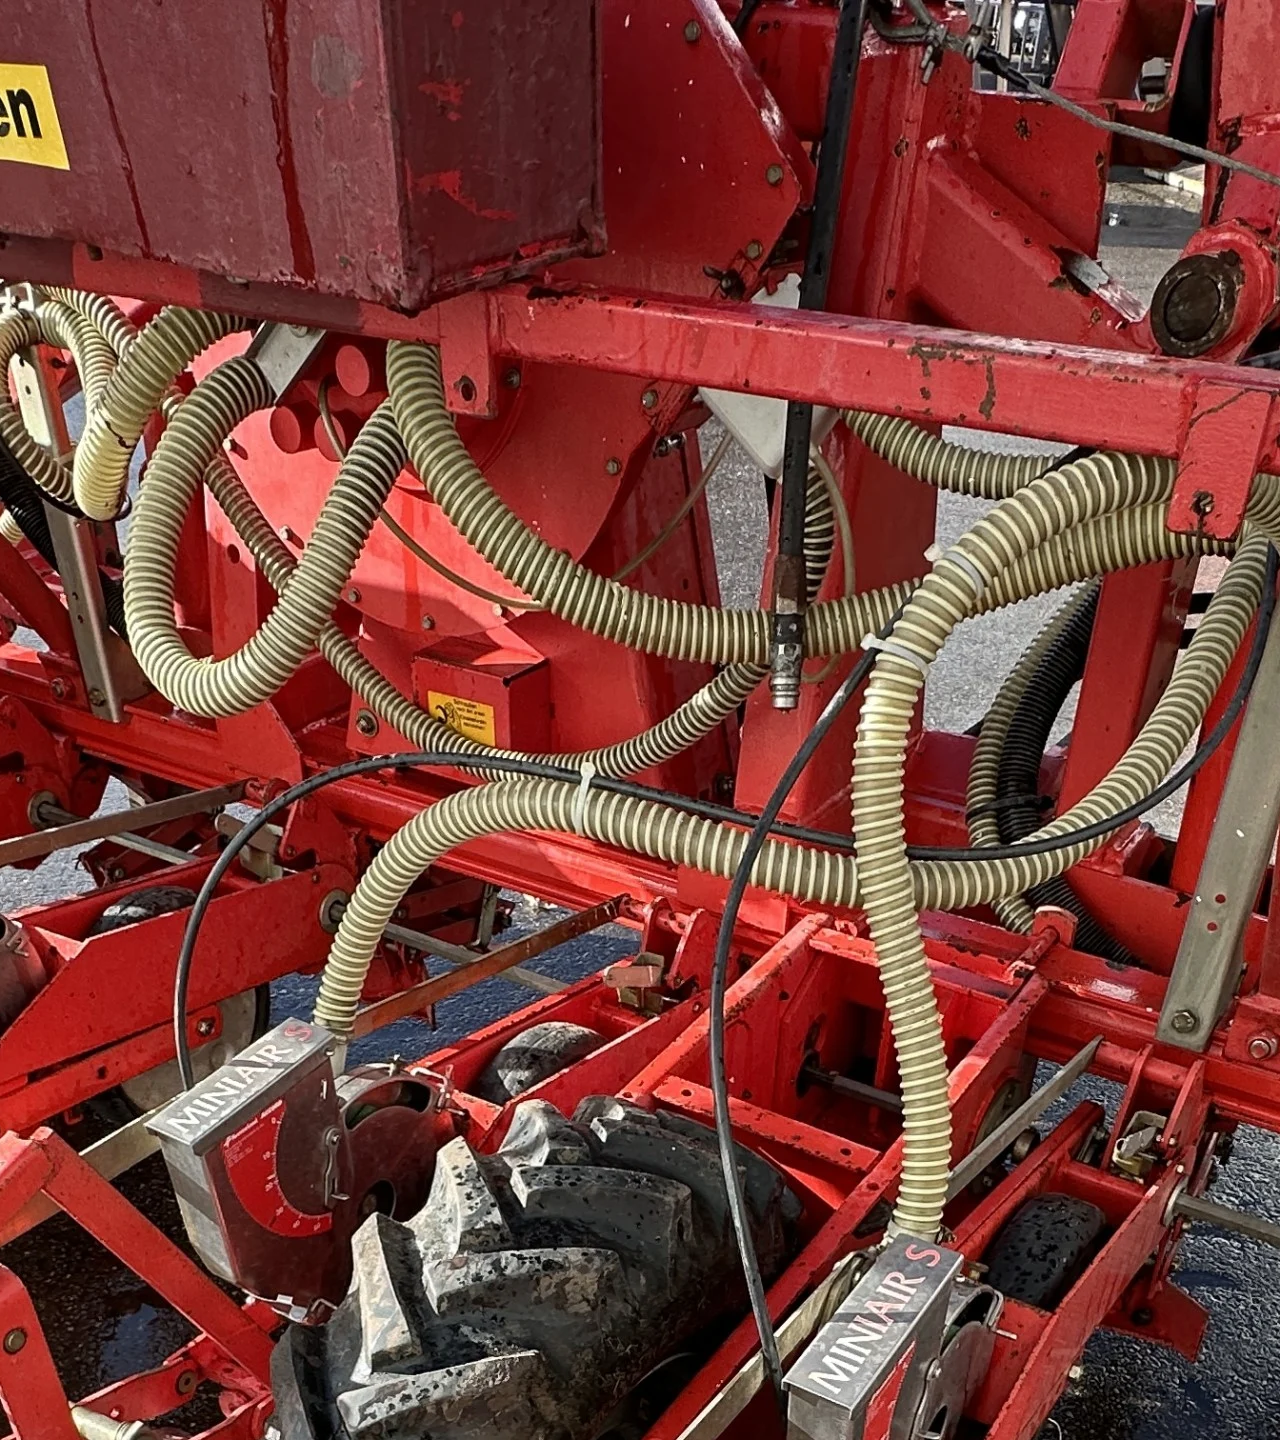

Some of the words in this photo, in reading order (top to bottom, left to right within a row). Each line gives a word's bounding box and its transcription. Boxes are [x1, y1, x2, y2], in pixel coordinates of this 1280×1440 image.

[167, 1044, 294, 1134] MINIAIR
[284, 1026, 312, 1041] S
[808, 1271, 926, 1395] MINIAIR
[905, 1244, 941, 1267] S
